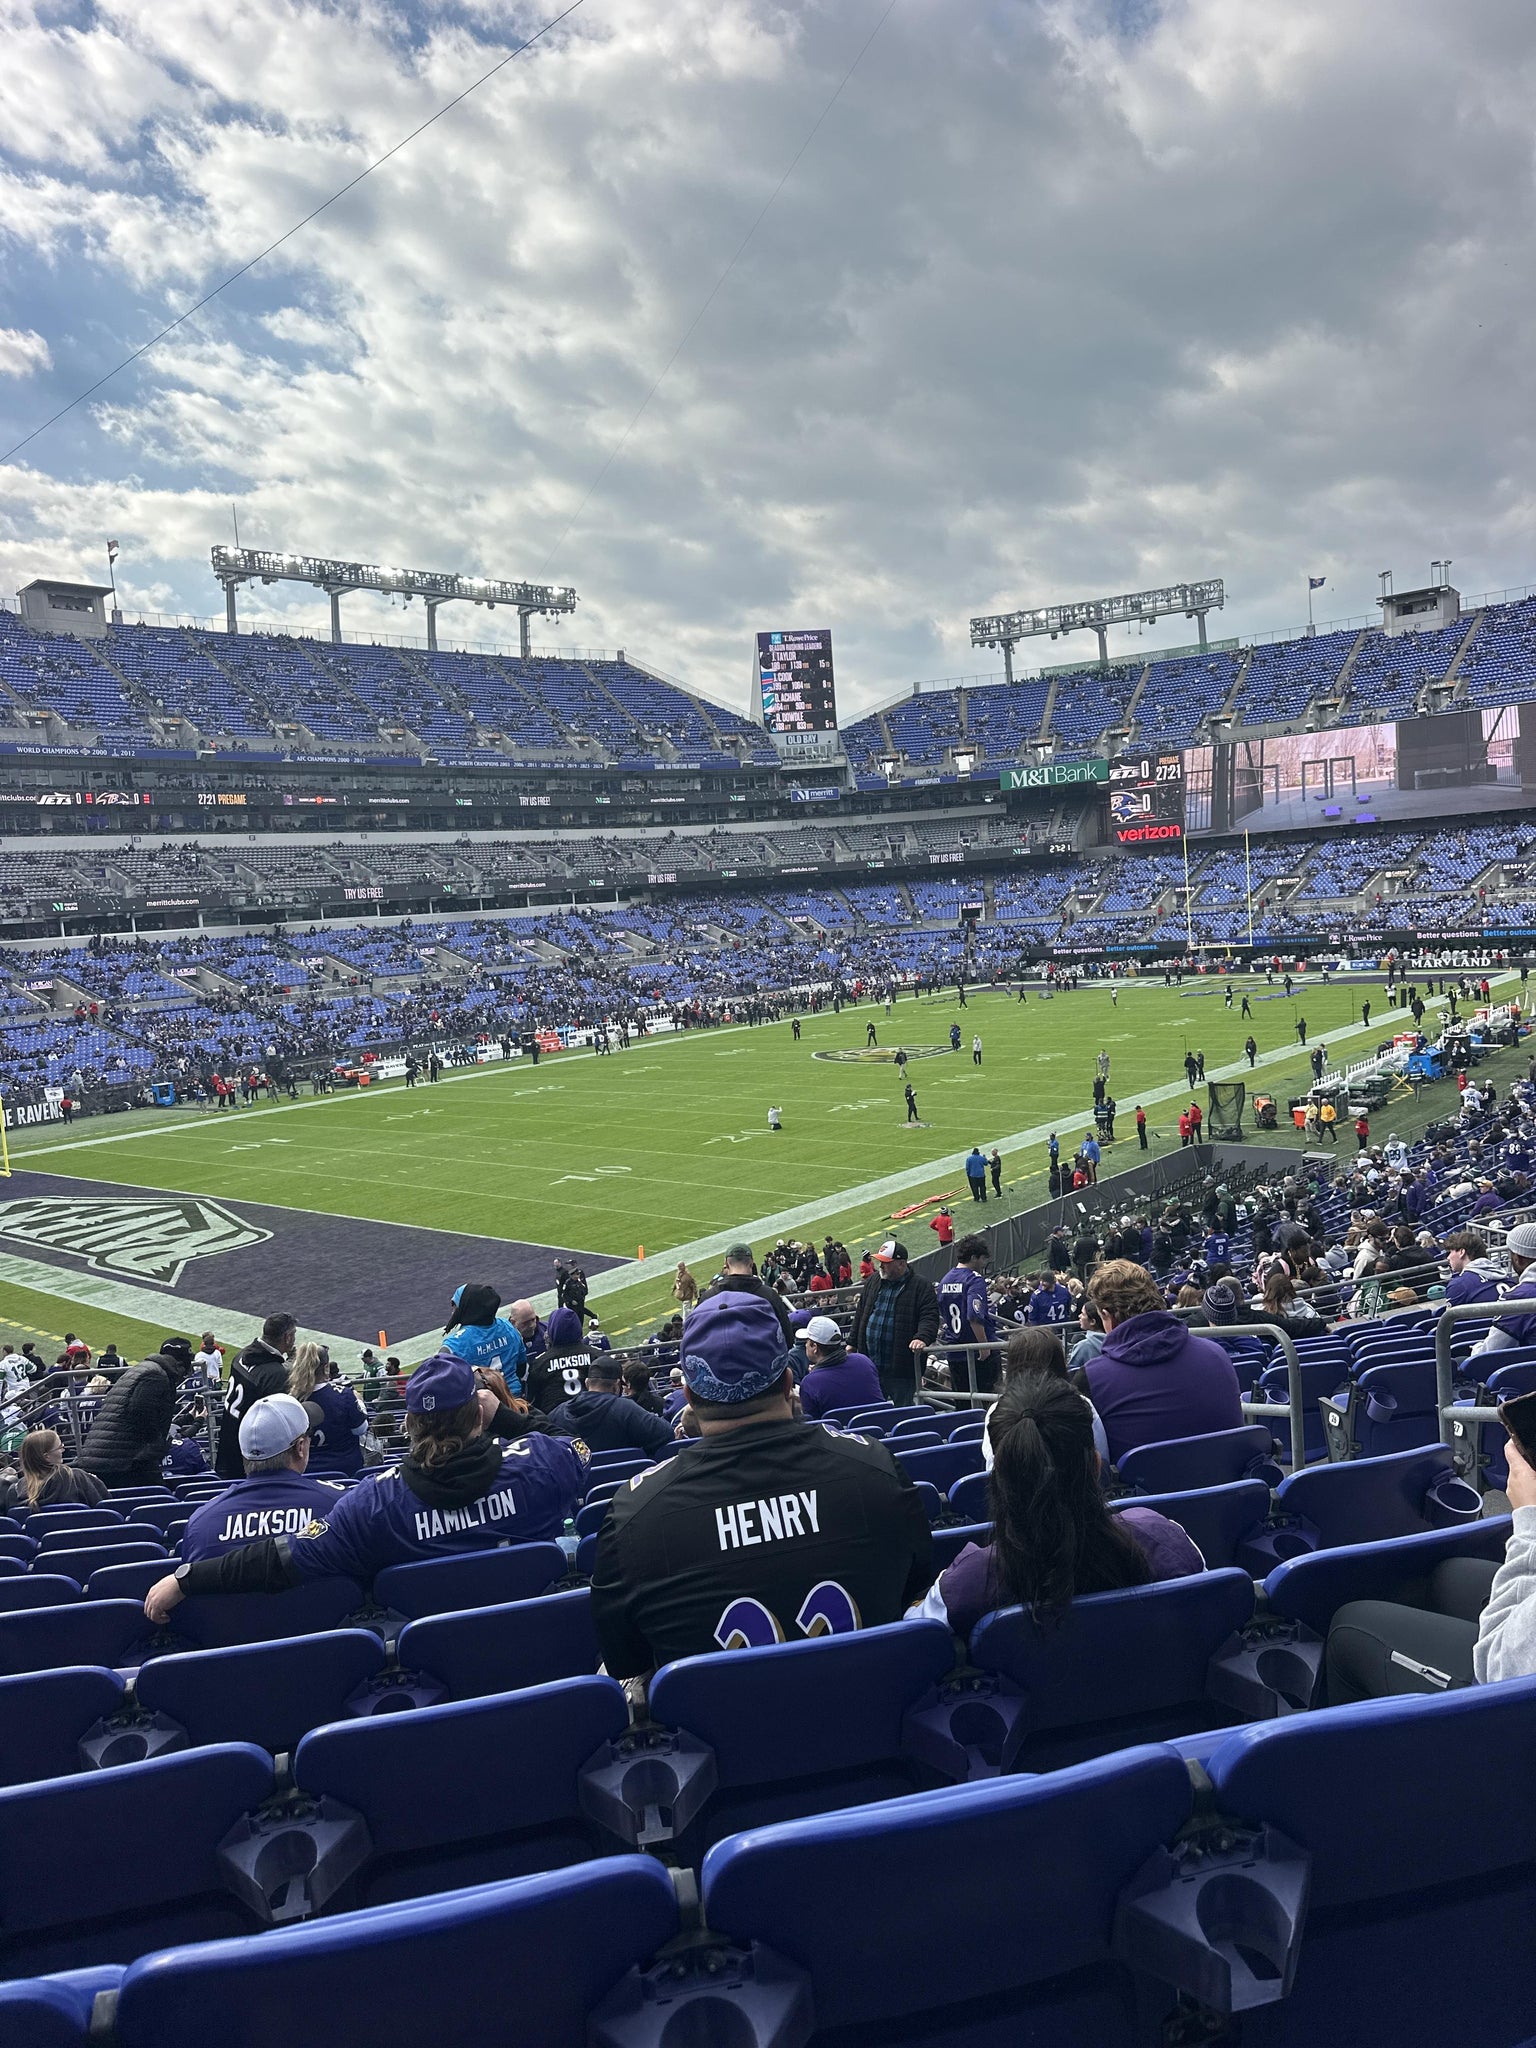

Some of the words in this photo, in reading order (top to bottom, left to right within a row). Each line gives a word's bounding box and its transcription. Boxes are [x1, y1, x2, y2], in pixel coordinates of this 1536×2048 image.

[778, 651, 797, 660] TAYLOR
[819, 660, 825, 668] 15
[781, 692, 802, 702] ACHANE
[788, 735, 802, 744] OLD
[803, 734, 817, 743] BAY
[1009, 768, 1053, 789] M&T
[1055, 763, 1098, 783] Bank
[1141, 761, 1149, 779] 0
[1156, 764, 1181, 781] 27:21
[37, 792, 72, 805] JETS
[75, 793, 82, 804] 0
[134, 793, 140, 804] 0
[198, 794, 216, 805] 27:21
[218, 794, 247, 805] PREGAME
[519, 796, 529, 806] TRY
[529, 797, 537, 806] US
[537, 796, 551, 806] FREE!
[1143, 793, 1151, 812] 0
[1117, 824, 1181, 842] verizon
[929, 854, 940, 864] TRY
[941, 854, 950, 863] US
[950, 853, 964, 862] FREE!
[664, 873, 677, 883] FREE!
[344, 888, 357, 900] TRY
[357, 888, 367, 899] US
[367, 887, 384, 898] FREE!
[146, 899, 200, 907] merrittclubs.com
[1342, 934, 1383, 942] T.RowePrice
[1441, 931, 1481, 940] questions.
[1483, 929, 1508, 937] Better
[1411, 958, 1492, 968] MARYLAND
[942, 1283, 963, 1294] JACKSON
[948, 1303, 962, 1334] 8
[1047, 1304, 1066, 1321] 42
[547, 1353, 591, 1373] JACKSON
[562, 1368, 582, 1396] 8
[414, 1488, 517, 1540] HAMILTON
[715, 1489, 820, 1550] HENRY
[218, 1508, 315, 1542] JACKSON
